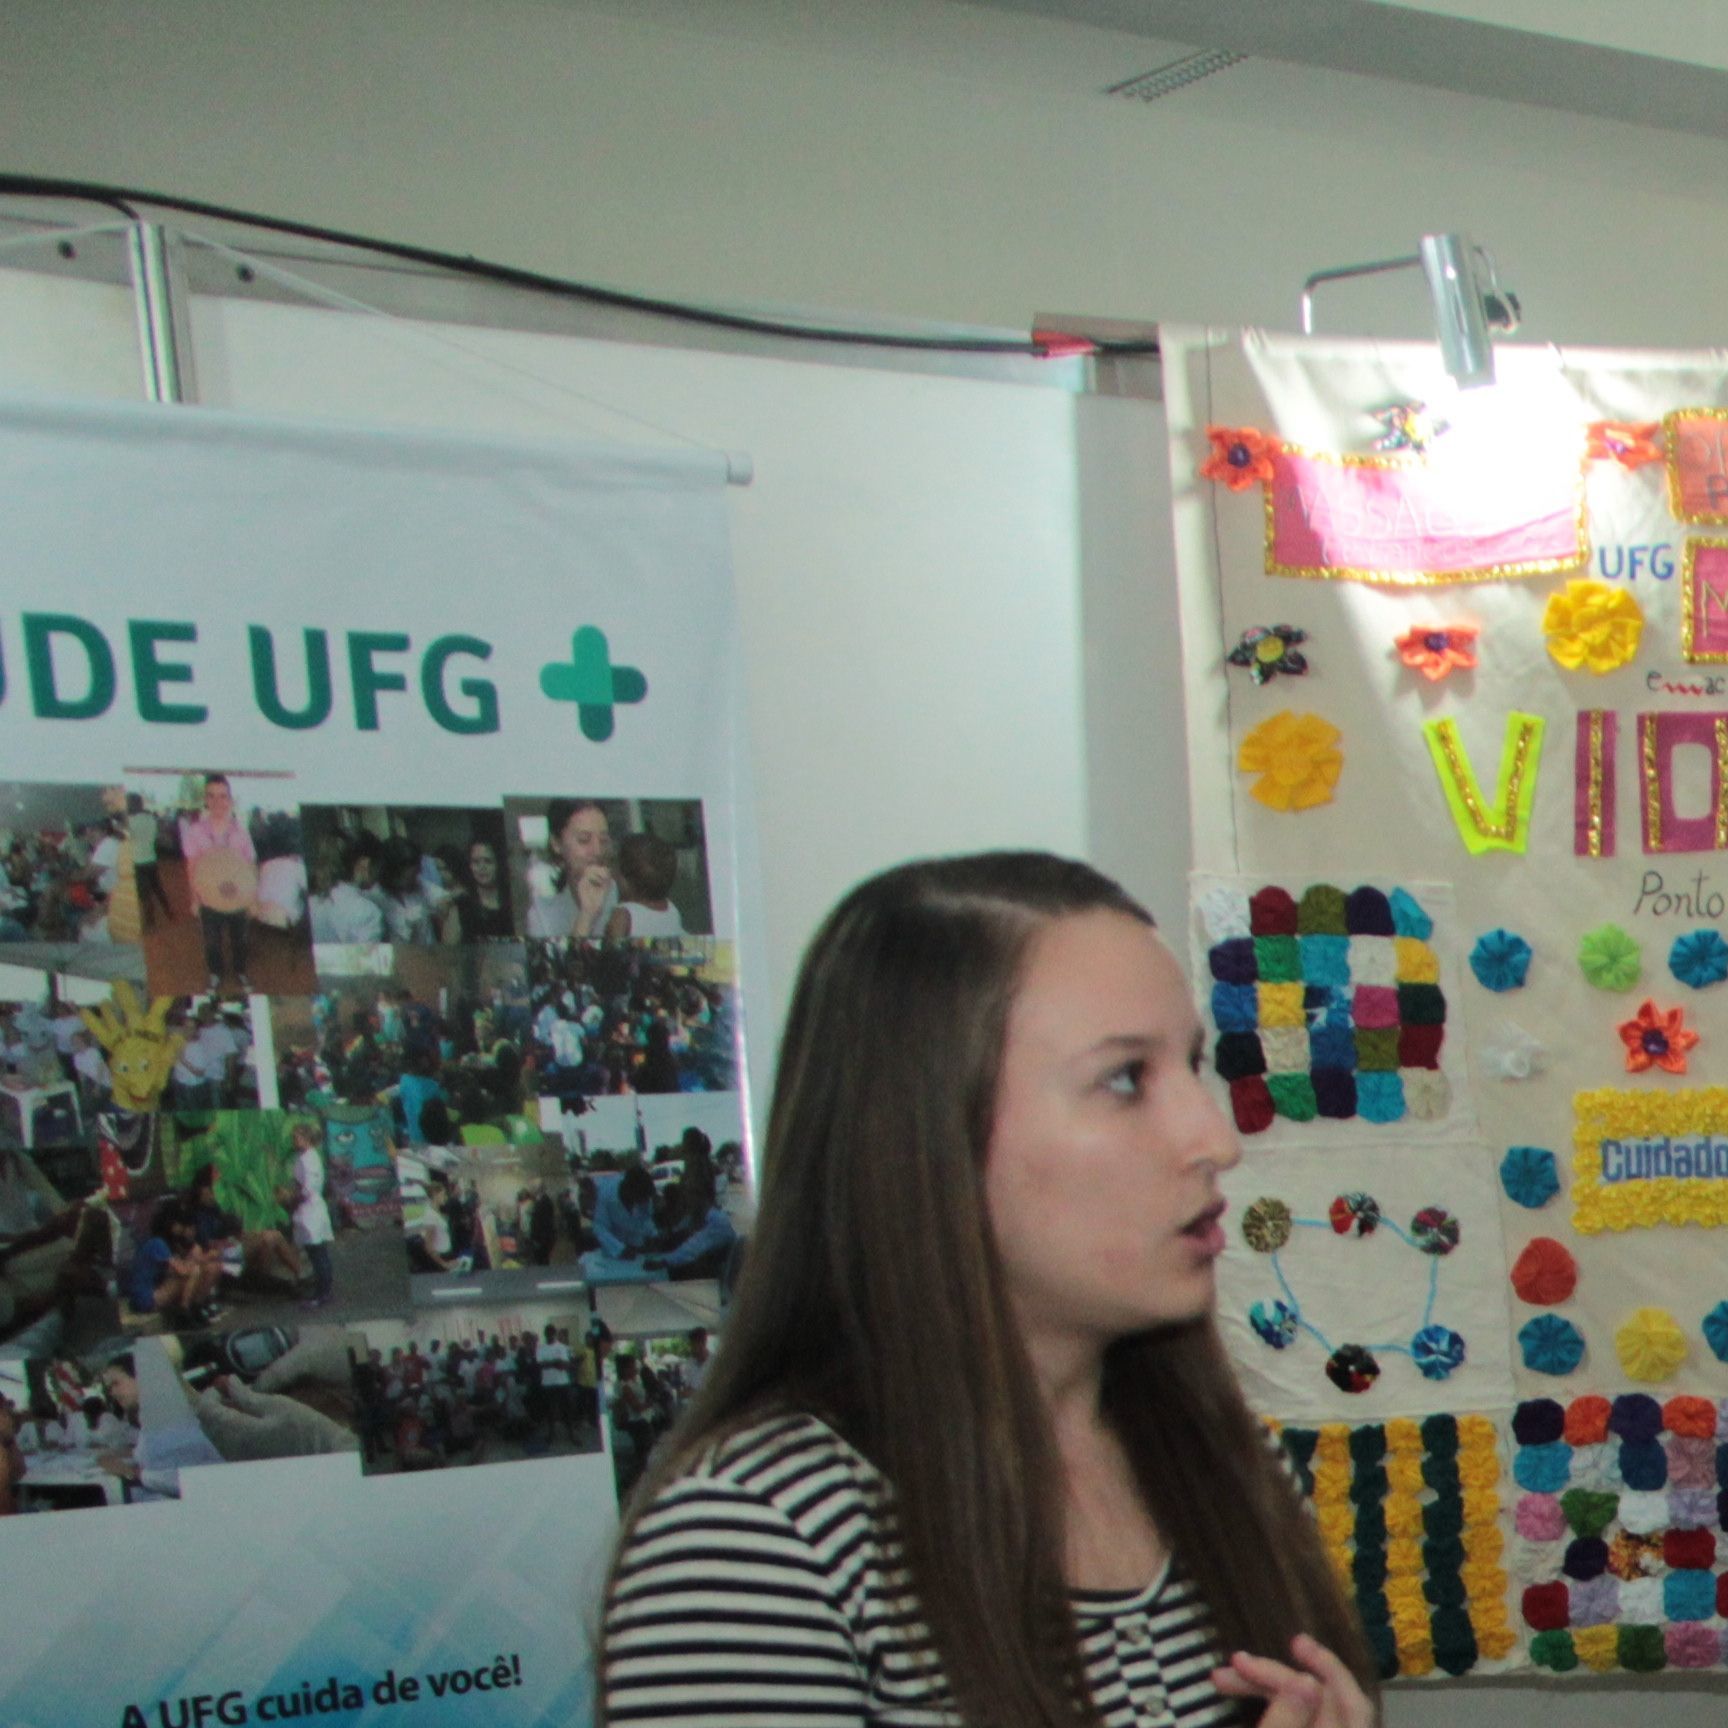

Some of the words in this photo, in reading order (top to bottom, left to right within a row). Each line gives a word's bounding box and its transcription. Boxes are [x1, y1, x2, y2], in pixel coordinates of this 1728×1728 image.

[1599, 544, 1675, 581] UFG
[0, 611, 209, 725] DE
[247, 622, 501, 735] UFG
[1632, 869, 1726, 920] Ponto
[256, 1678, 364, 1722] cuida
[372, 1670, 420, 1708] de
[427, 1654, 524, 1698] você!
